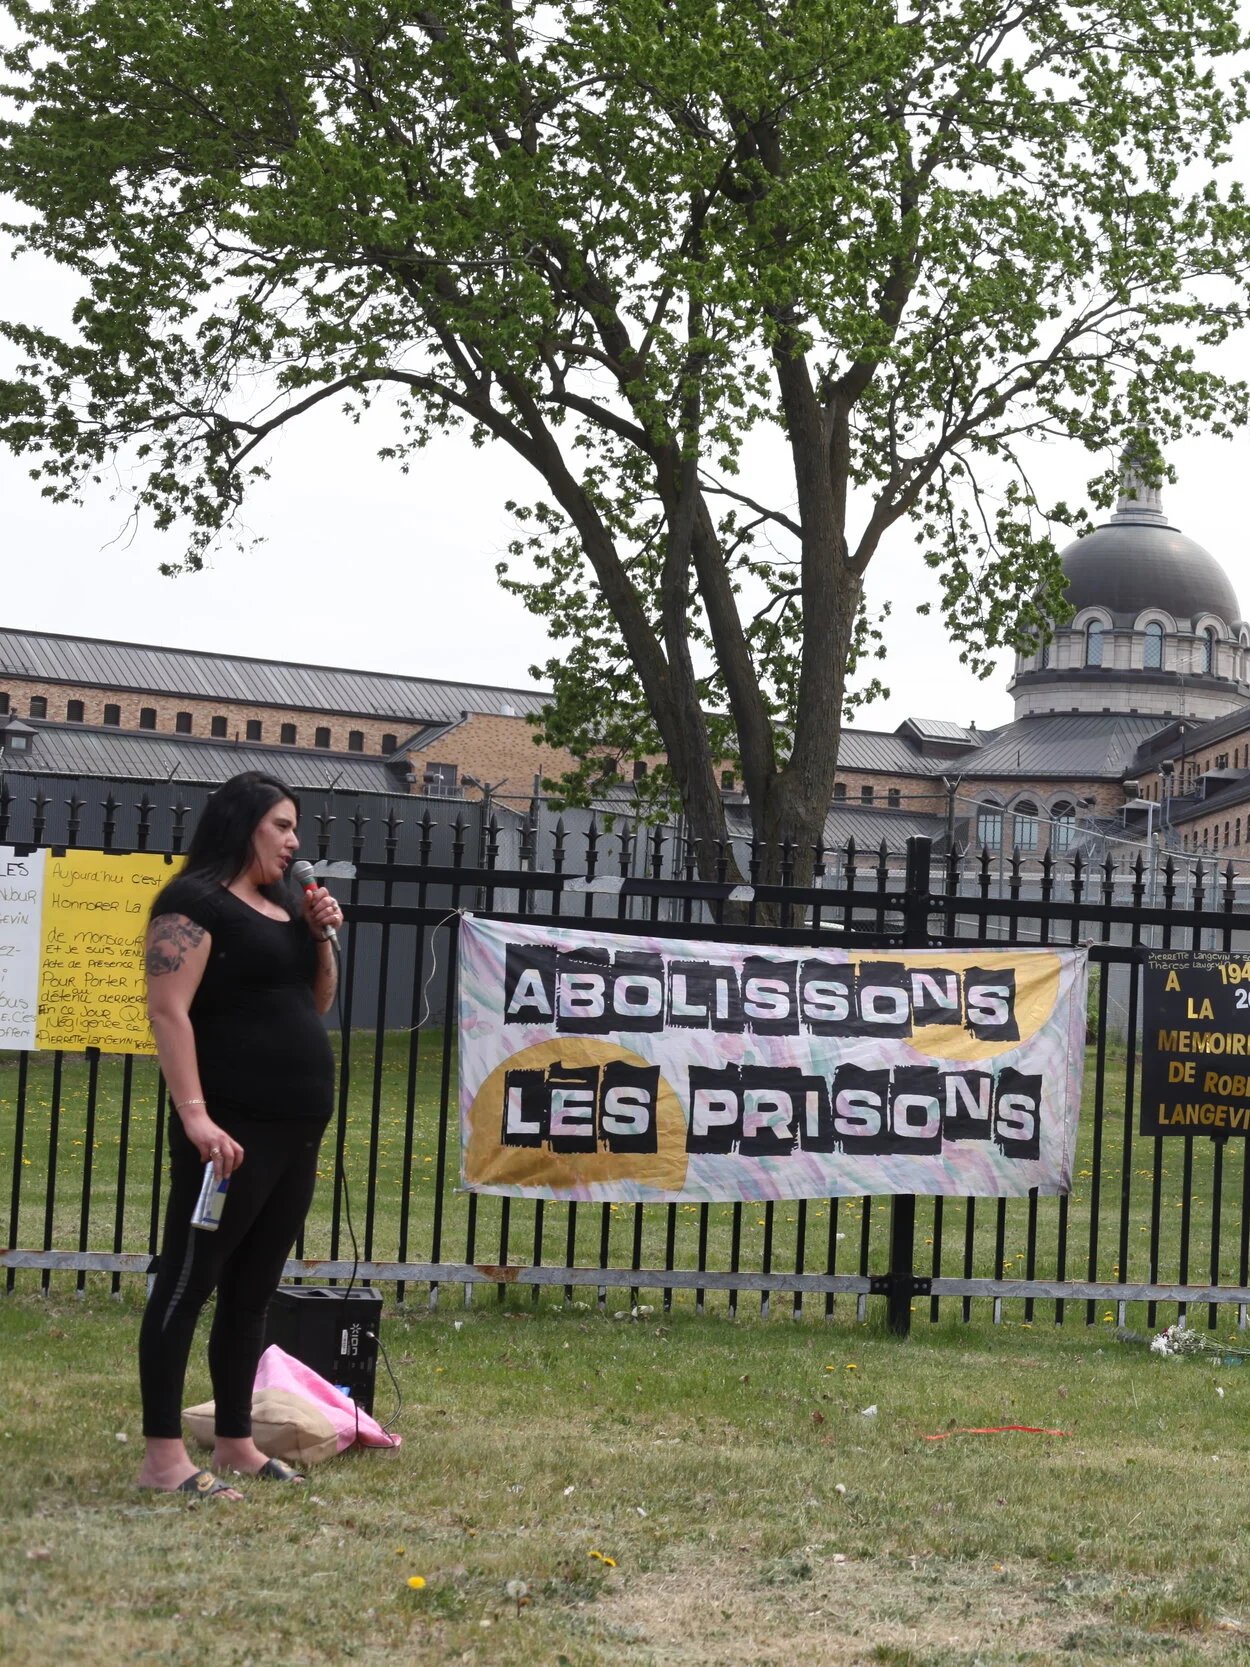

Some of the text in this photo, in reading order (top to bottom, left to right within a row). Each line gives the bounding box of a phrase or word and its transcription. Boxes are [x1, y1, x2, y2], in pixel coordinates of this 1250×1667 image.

[48, 927, 66, 943] de
[1165, 970, 1181, 992] A
[507, 968, 1011, 1026] ABOLISSONS
[1187, 998, 1214, 1020] LA
[1168, 1061, 1196, 1083] DE
[507, 1075, 1034, 1142] LES PRISONS
